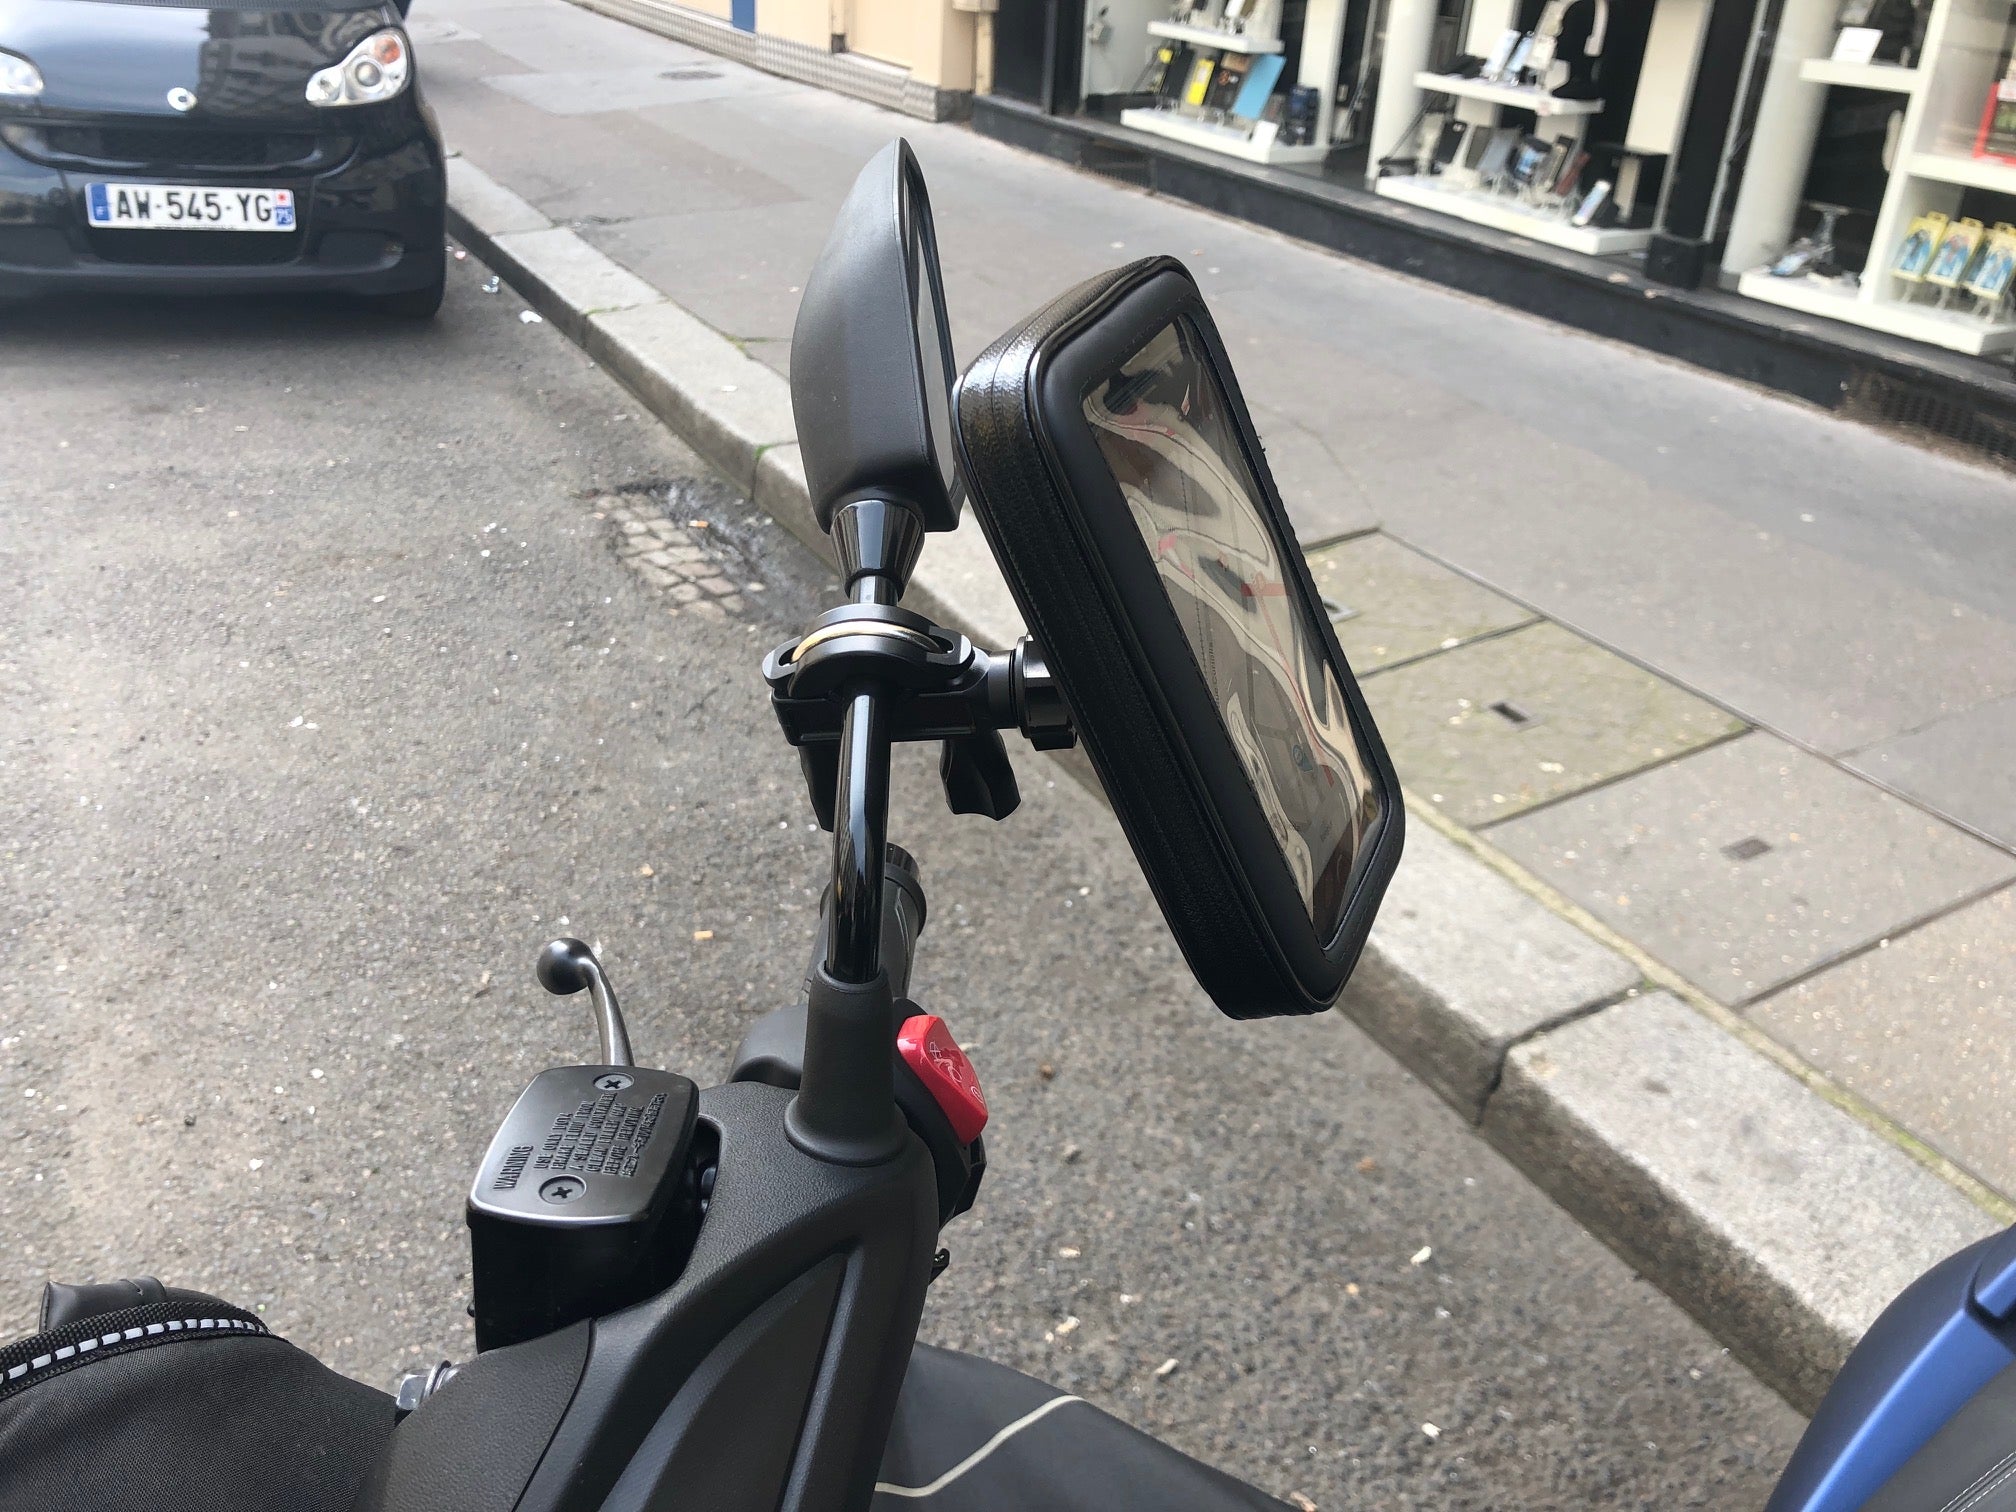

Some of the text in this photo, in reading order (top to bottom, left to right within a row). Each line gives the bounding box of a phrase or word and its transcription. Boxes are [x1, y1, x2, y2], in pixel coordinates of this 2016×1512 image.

[116, 190, 272, 222] AW-545-YG
[542, 1133, 563, 1150] ONLY
[492, 1145, 534, 1189] WARNING
[533, 1154, 554, 1169] USE
[550, 1145, 575, 1169] BRAKE
